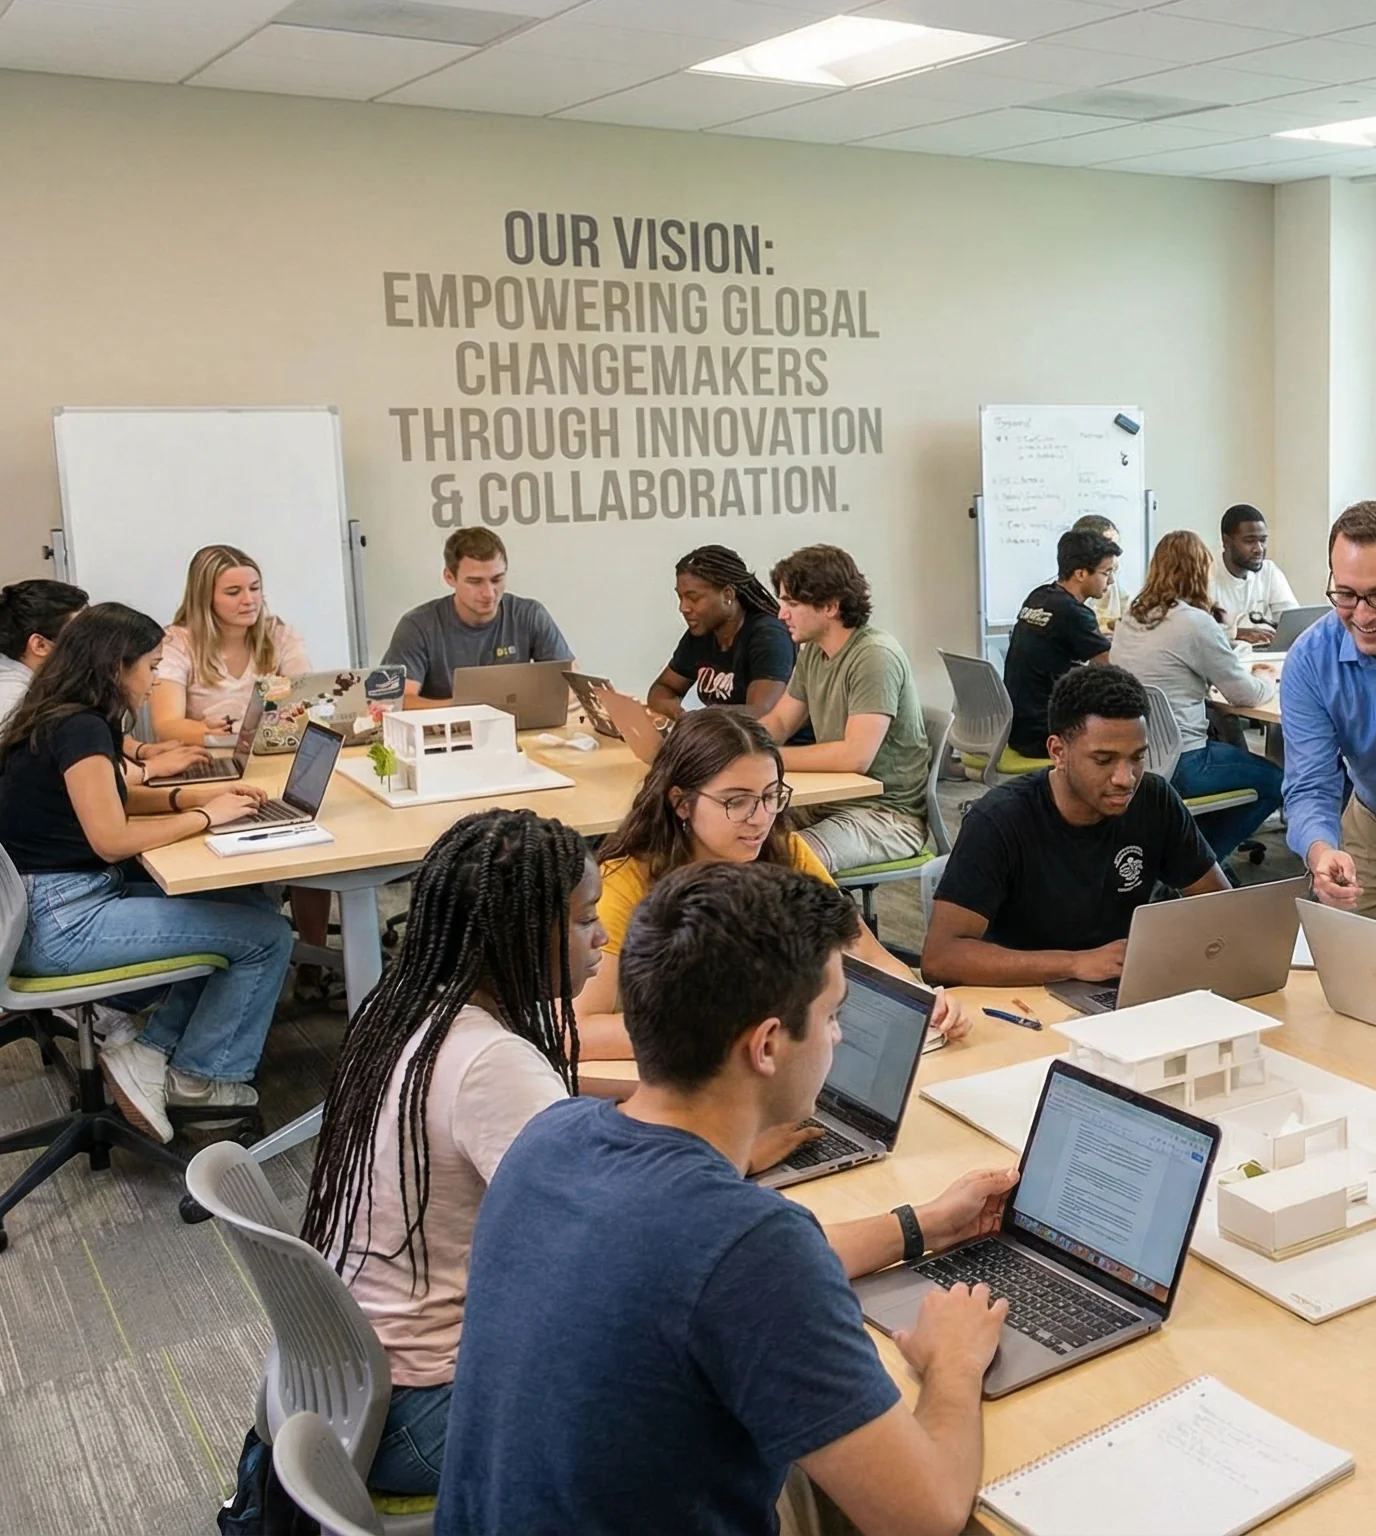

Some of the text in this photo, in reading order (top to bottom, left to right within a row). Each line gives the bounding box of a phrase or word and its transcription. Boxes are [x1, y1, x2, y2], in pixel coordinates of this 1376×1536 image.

[504, 210, 775, 276] OUR VISION:
[382, 271, 880, 339] EMPOWERING GLOBAL
[455, 340, 829, 397] CHANGEMAKERS
[388, 406, 884, 462] THROUGH INNOVATION
[430, 465, 850, 529] & COLLABORATION.
